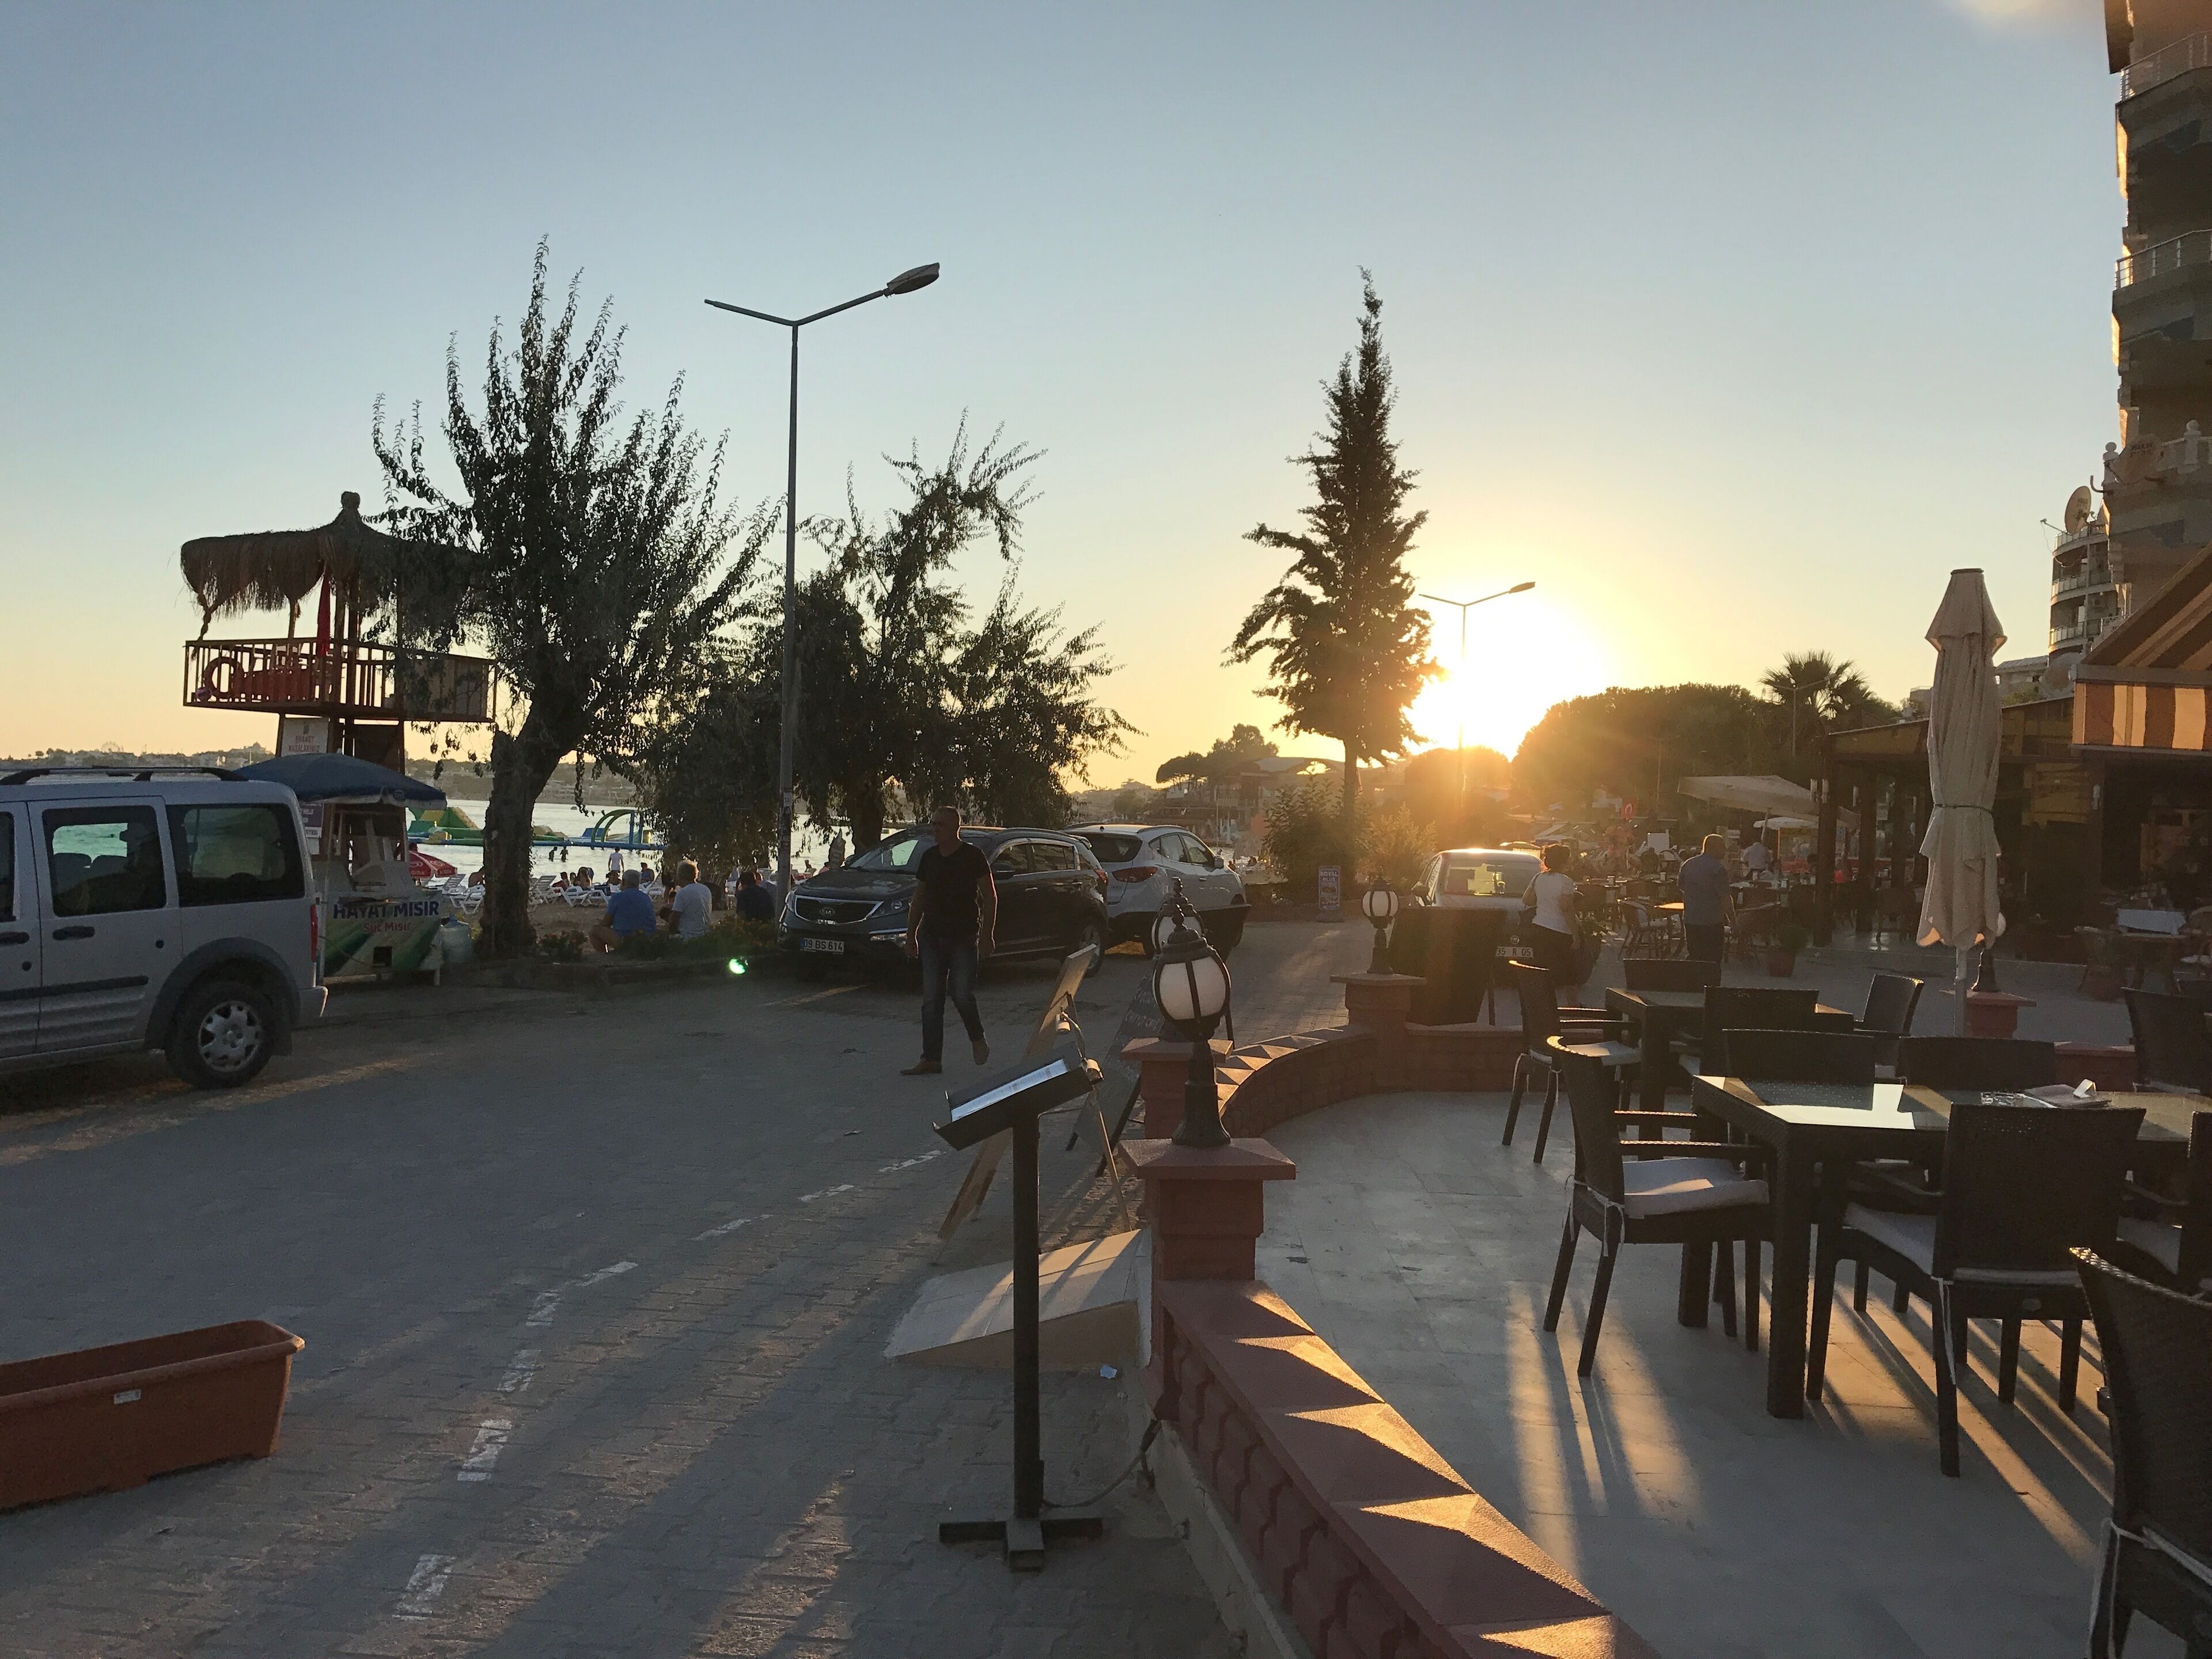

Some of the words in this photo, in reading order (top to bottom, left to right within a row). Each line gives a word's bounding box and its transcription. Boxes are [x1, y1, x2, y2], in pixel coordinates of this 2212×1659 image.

[334, 904, 387, 919] HAYAT
[393, 901, 439, 918] MISIR
[804, 939, 813, 948] 09
[815, 940, 826, 949] BS
[828, 941, 842, 951] 614
[1512, 948, 1517, 956] R
